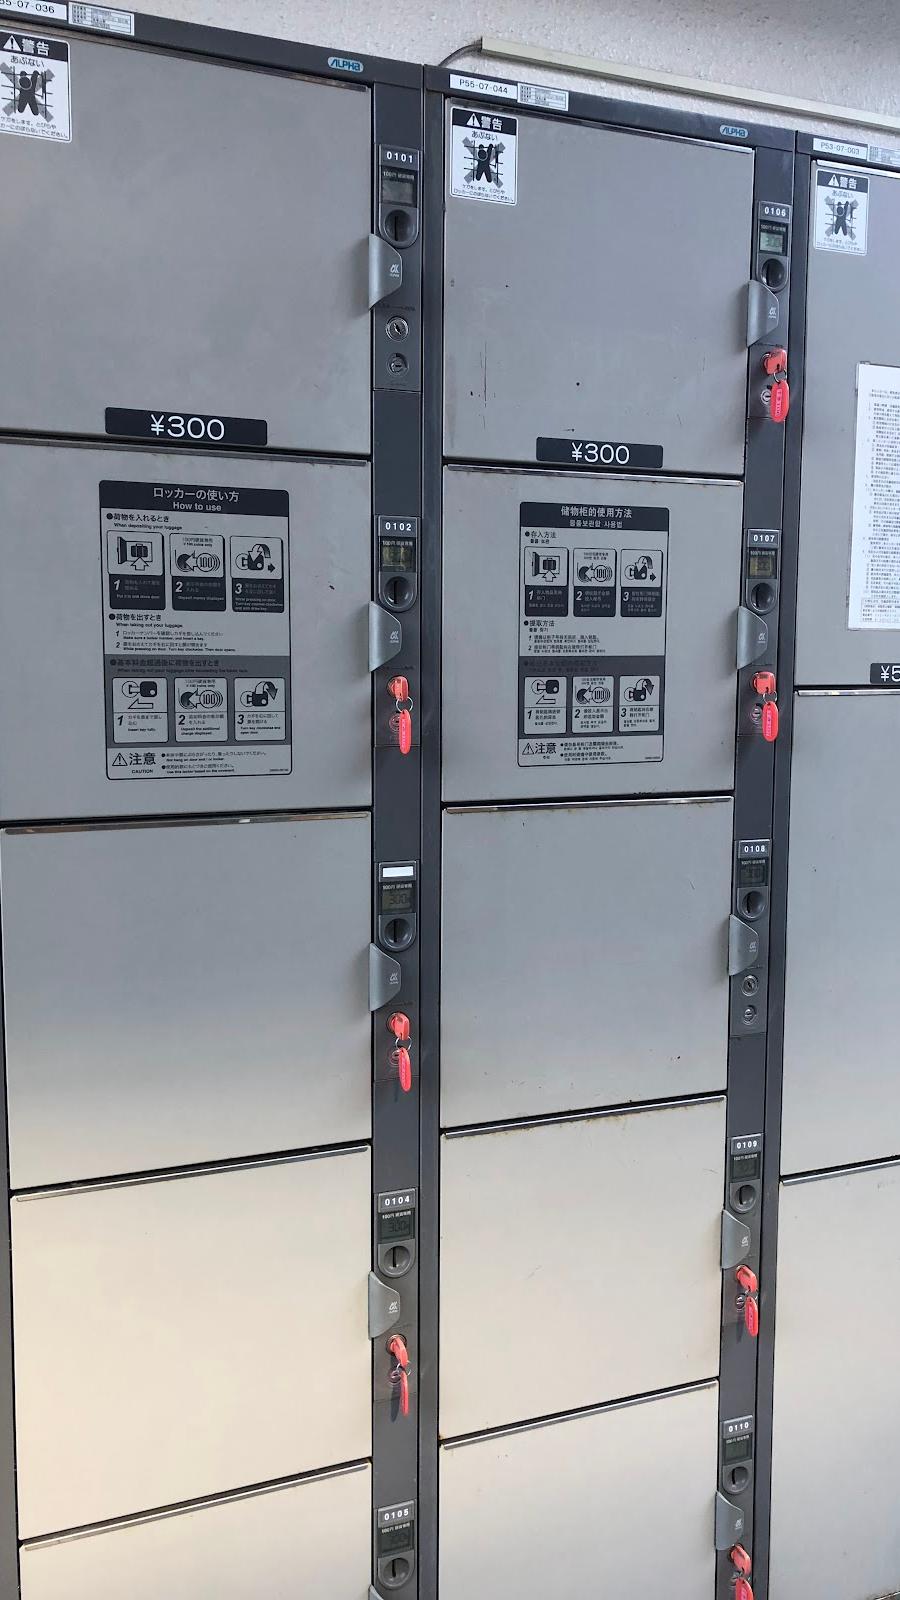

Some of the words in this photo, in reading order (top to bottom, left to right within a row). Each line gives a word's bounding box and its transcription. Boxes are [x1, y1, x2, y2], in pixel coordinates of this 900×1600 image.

[22, 38, 50, 56] 警告
[11, 55, 45, 68] あぶない
[331, 58, 361, 71] ALPHA
[460, 79, 508, 94] P55-07-044
[481, 115, 503, 132] 警告
[472, 130, 498, 142] あぶない
[721, 126, 749, 138] ALPHA
[820, 142, 860, 156] P53-07-003
[386, 151, 413, 163] 0101
[839, 175, 858, 190] 警告
[765, 206, 786, 217] 0106
[150, 413, 225, 441] ¥300
[571, 442, 630, 465] ¥300
[153, 487, 239, 503] ロッカーの使い方
[173, 501, 193, 510] How
[194, 502, 204, 511] to
[205, 503, 222, 512] use
[561, 505, 632, 519] 储物柜的使用方法
[114, 513, 169, 523] 荷物を入れるとき
[385, 521, 412, 531] 0102
[603, 521, 623, 529] 사용법
[531, 530, 557, 539] 存入方法
[753, 534, 776, 543] 0107
[200, 556, 212, 568] 100
[596, 568, 607, 578] 100
[114, 579, 121, 591] 1
[175, 581, 184, 593] 2
[235, 583, 243, 594] 3
[528, 589, 534, 601] 1
[575, 590, 583, 601] 2
[622, 591, 630, 602] 3
[116, 613, 162, 622] 荷物を出すとき
[530, 619, 555, 627] 提取方法
[203, 693, 216, 705] 100
[527, 710, 532, 720] 1
[574, 708, 581, 719] 2
[620, 707, 627, 718] 3
[117, 715, 124, 726] 1
[178, 714, 186, 725] 2
[237, 714, 245, 725] 3
[534, 742, 557, 755] 注意
[129, 752, 157, 766] 注意
[744, 844, 766, 853] 0108
[736, 1140, 758, 1150] 0109
[384, 1195, 410, 1206] 0104
[728, 1421, 749, 1433] 0110
[384, 1508, 409, 1521] 0105
